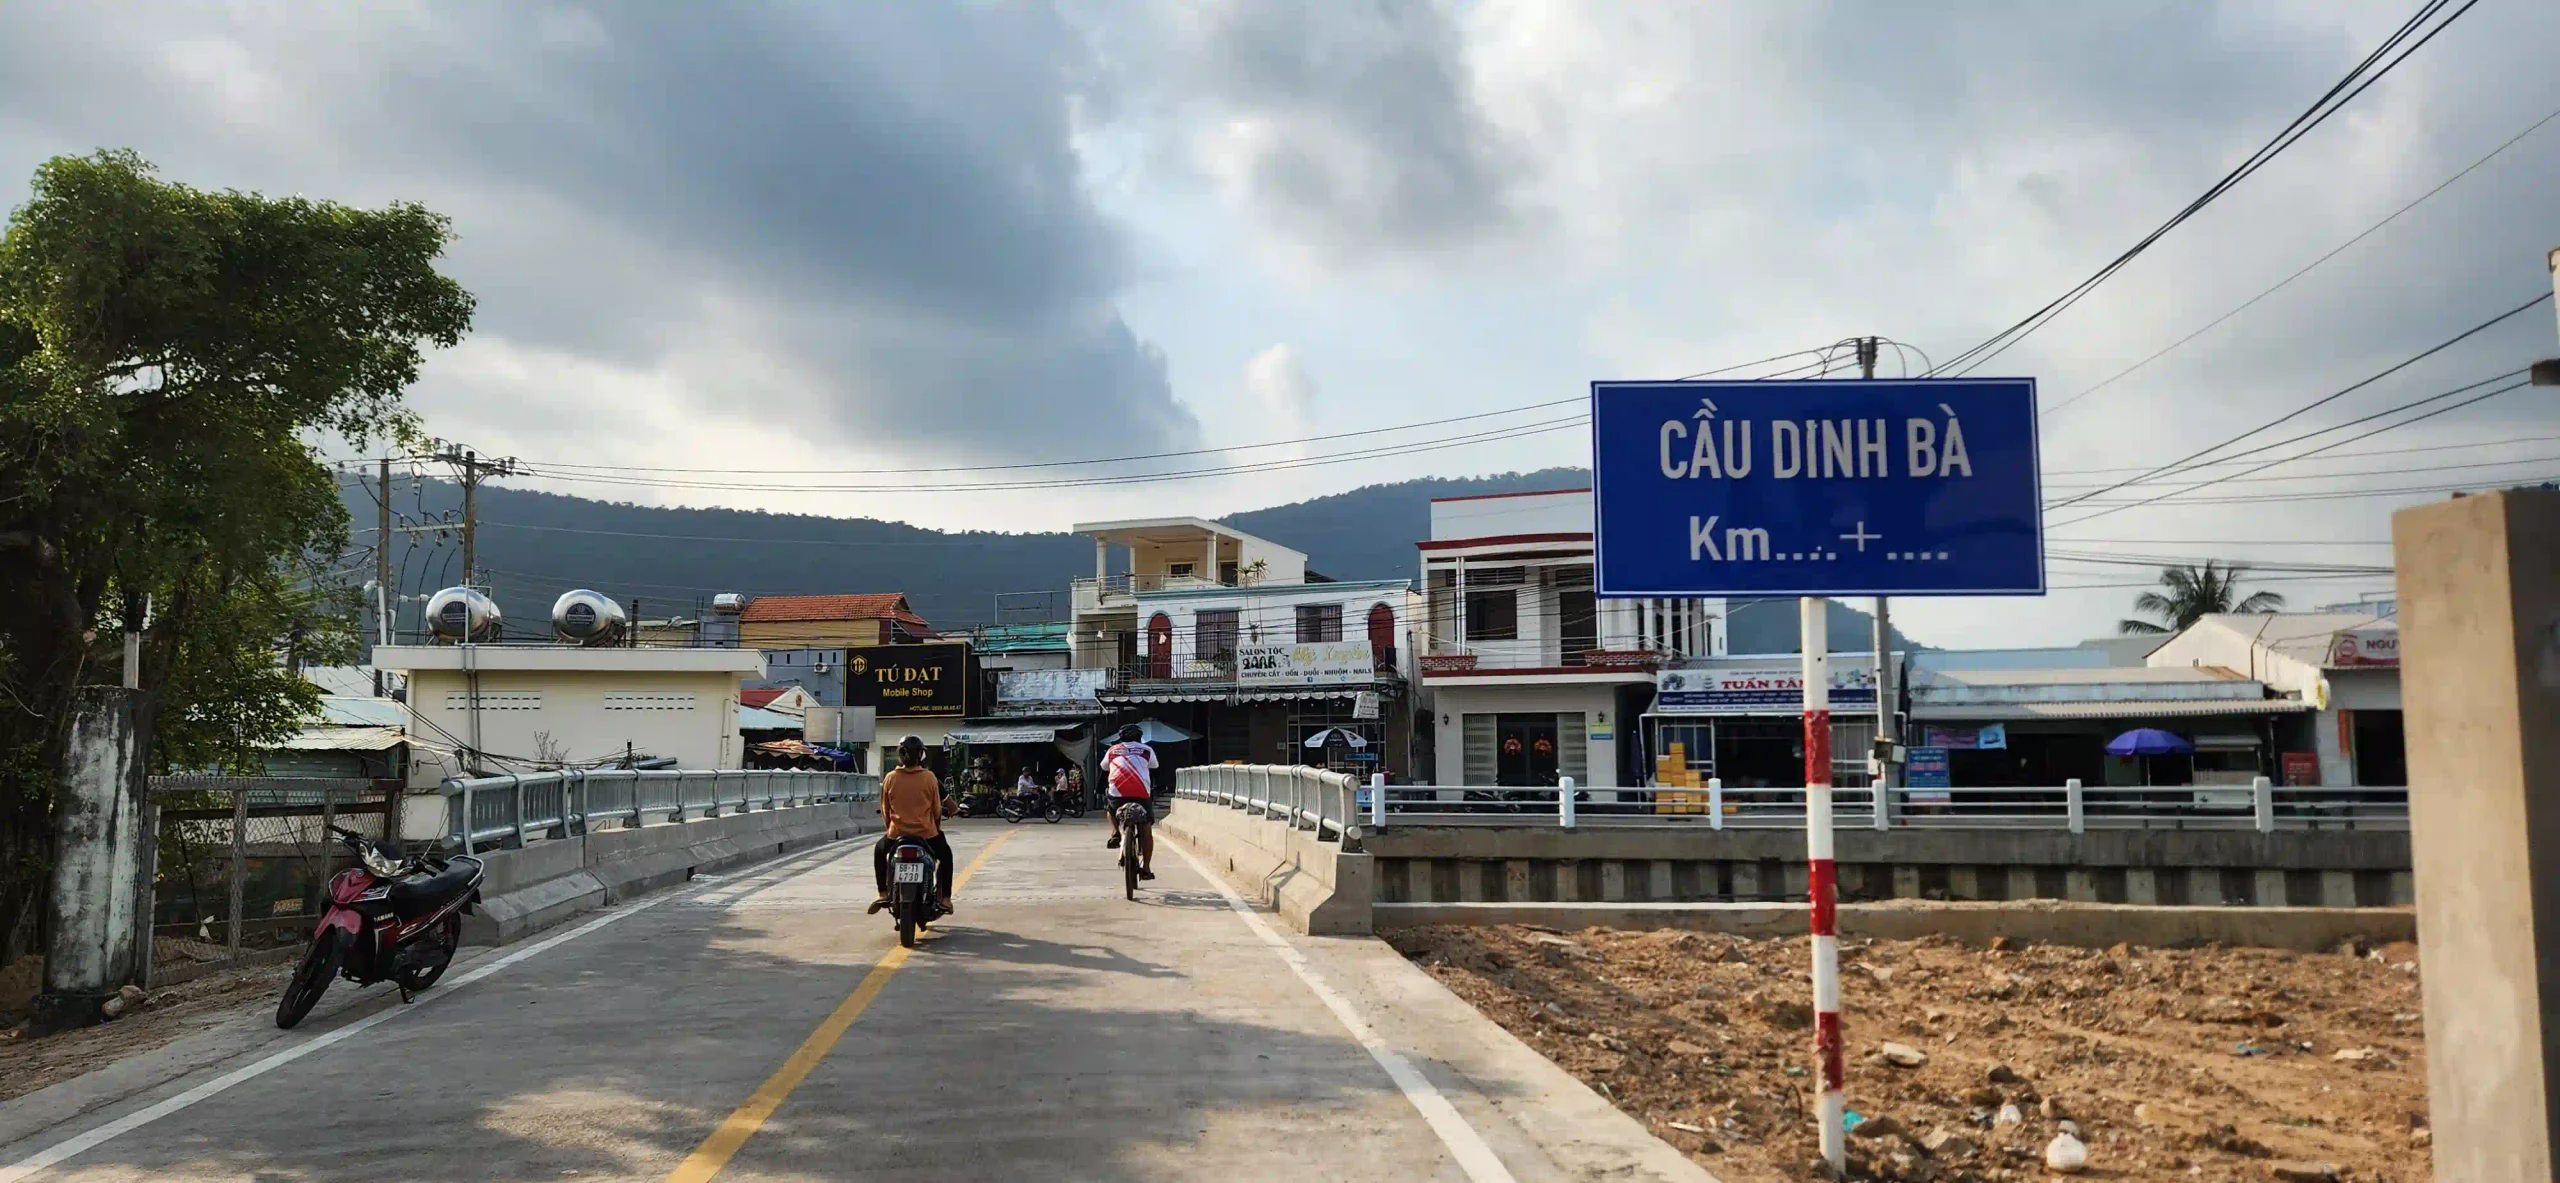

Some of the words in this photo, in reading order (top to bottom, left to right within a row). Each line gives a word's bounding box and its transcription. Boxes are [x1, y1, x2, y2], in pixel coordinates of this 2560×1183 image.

[1660, 398, 1752, 480] CẦU
[1772, 418, 1888, 479] DINH
[1906, 403, 1973, 478] BÀ
[2366, 638, 2400, 650] NGU
[1239, 648, 1266, 656] SALON
[874, 663, 899, 683] TÚ
[904, 666, 943, 684] ĐẠT
[1721, 676, 1770, 690] TUẤN
[882, 687, 910, 697] Mobile
[911, 687, 934, 698] Shop
[898, 872, 919, 881] 4730
[373, 911, 394, 922] YAMAHA
